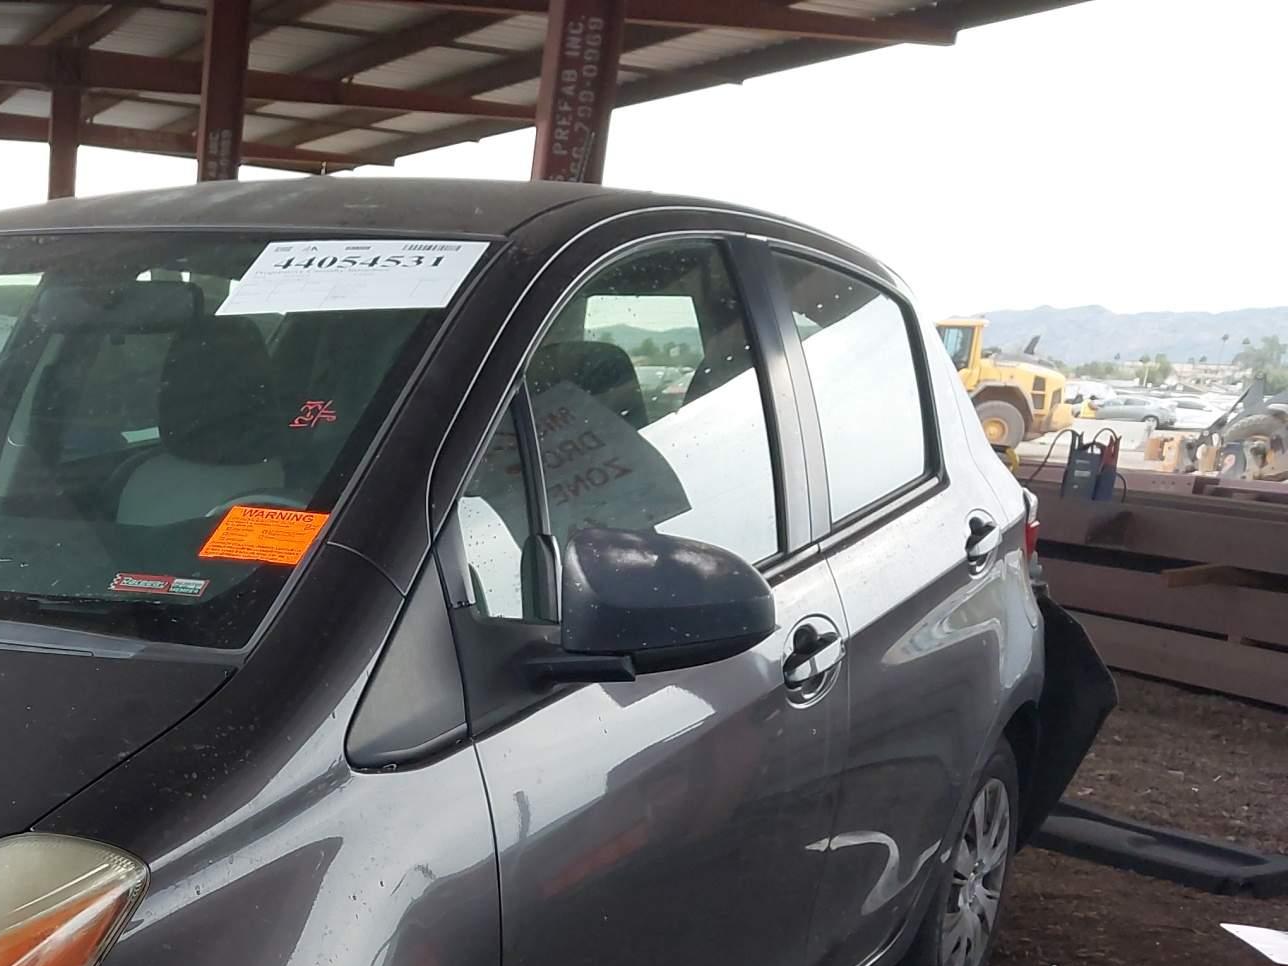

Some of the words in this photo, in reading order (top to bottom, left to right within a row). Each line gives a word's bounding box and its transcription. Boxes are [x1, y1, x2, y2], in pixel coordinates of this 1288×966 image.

[565, 15, 586, 57] INC.
[553, 70, 578, 156] PREFAB
[273, 255, 445, 270] 44054531
[242, 507, 315, 523] WARNING
